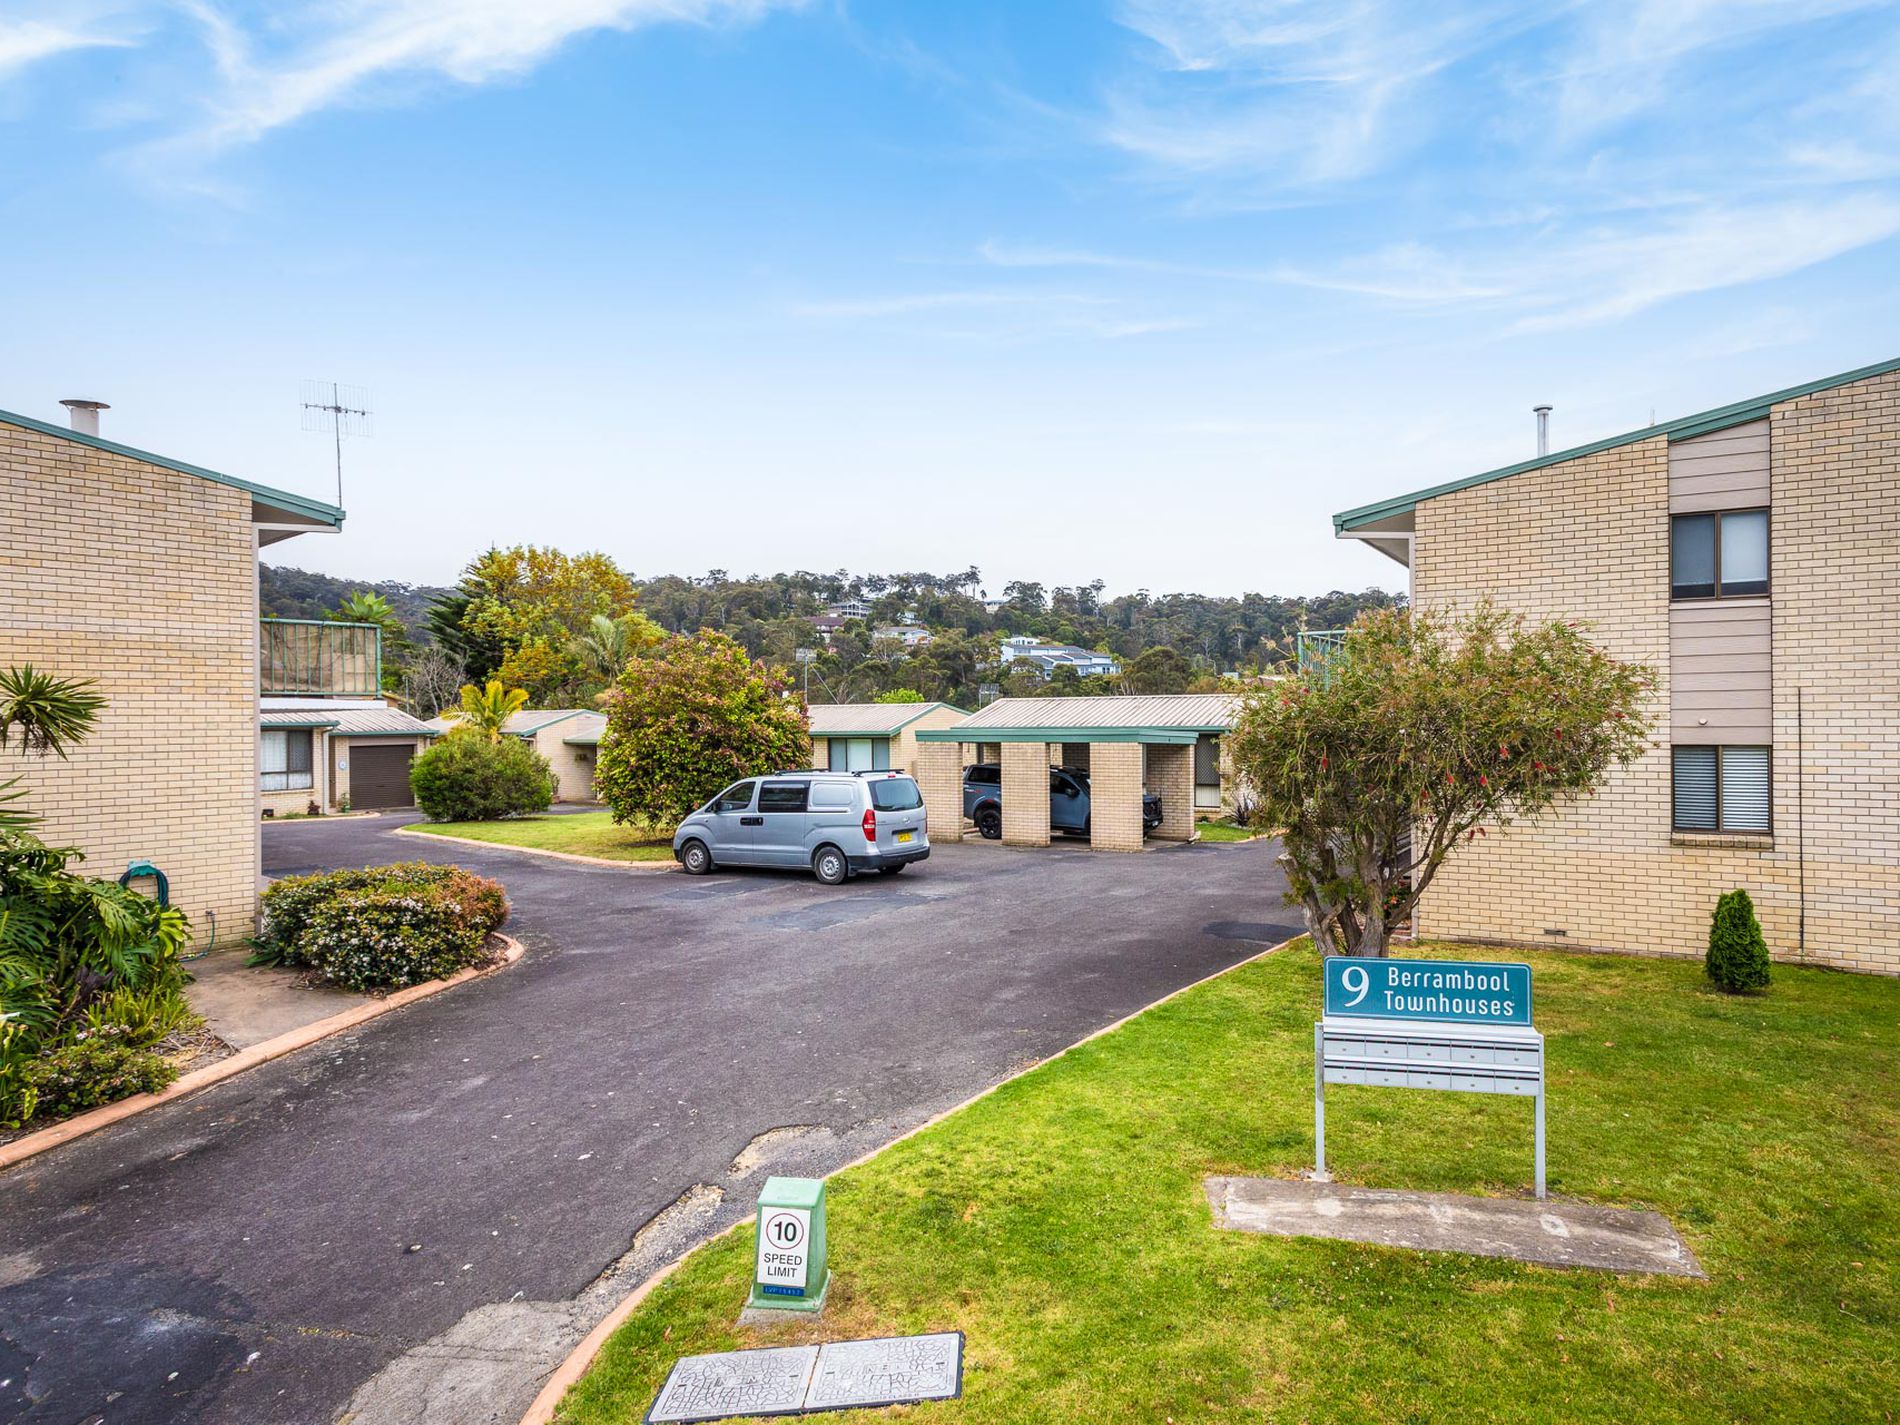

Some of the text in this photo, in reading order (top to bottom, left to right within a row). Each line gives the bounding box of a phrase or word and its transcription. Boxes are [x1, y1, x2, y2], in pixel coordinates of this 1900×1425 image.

[1341, 966, 1370, 1007] 9
[1388, 967, 1510, 992] Berrambool
[1384, 990, 1515, 1016] Townhouses
[774, 1221, 797, 1242] 10
[763, 1252, 803, 1266] SPEED
[767, 1266, 798, 1278] LIMIT
